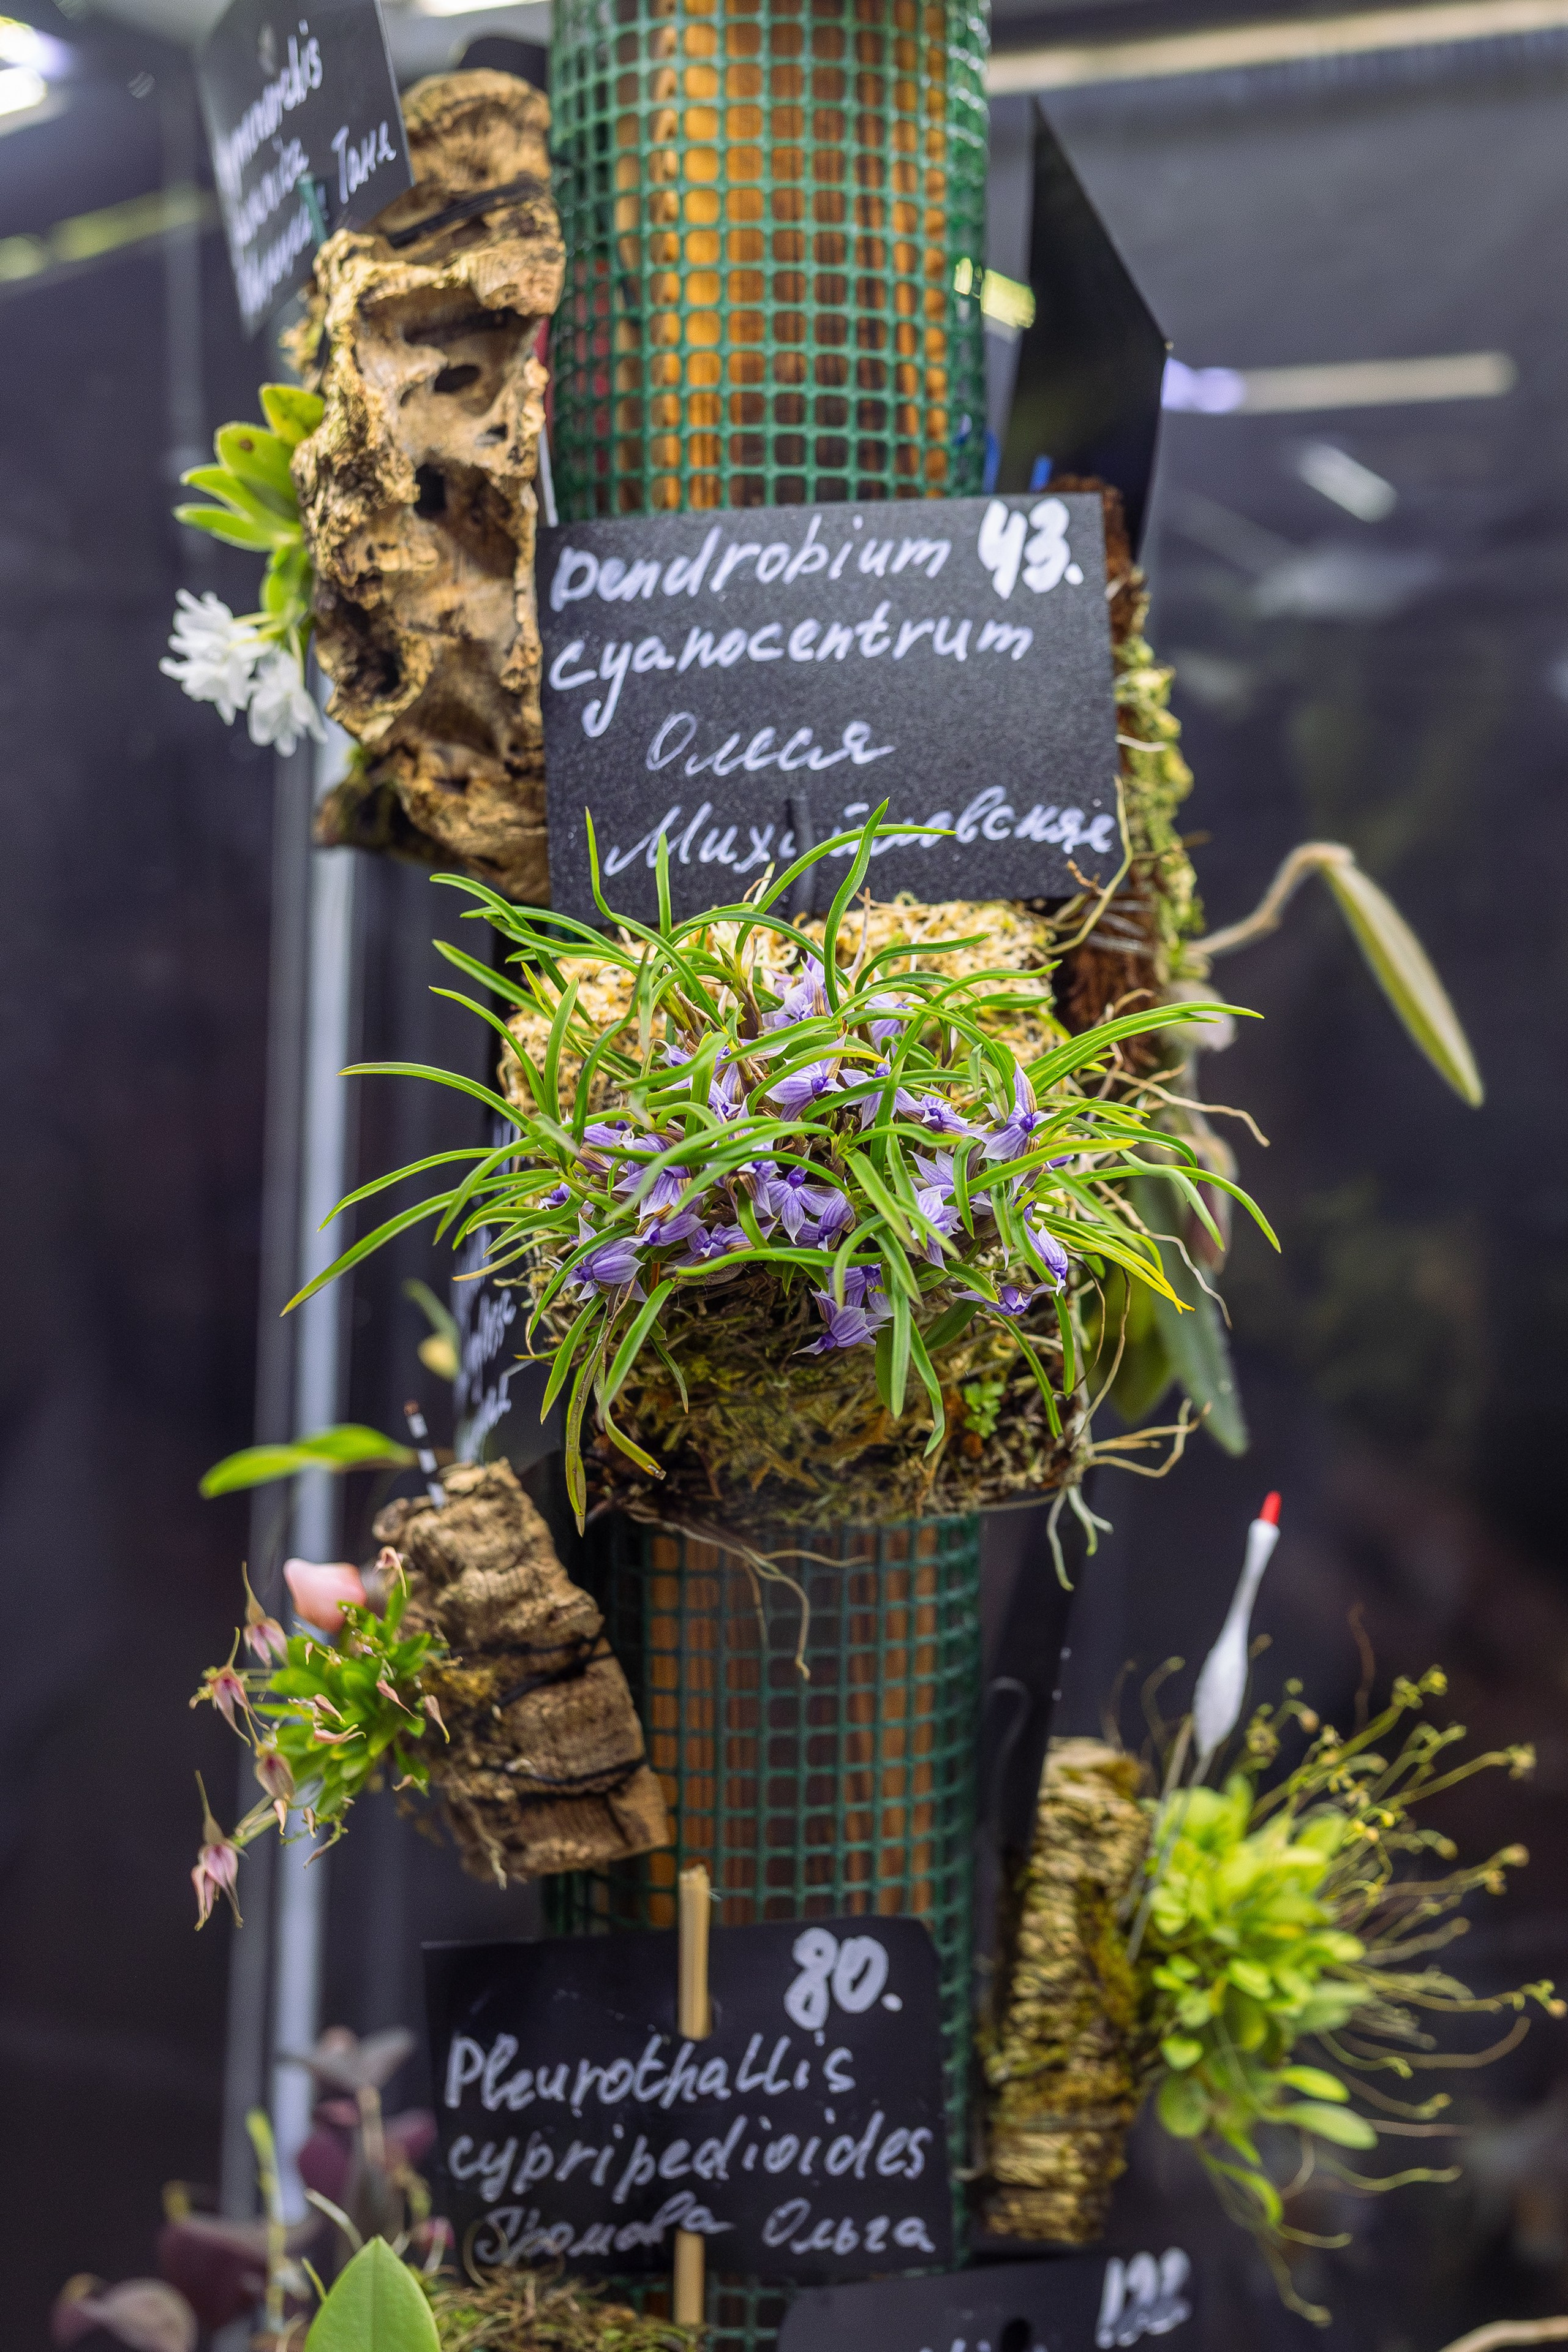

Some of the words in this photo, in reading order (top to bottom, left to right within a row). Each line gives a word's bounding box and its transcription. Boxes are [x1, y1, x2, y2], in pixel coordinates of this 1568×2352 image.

[551, 513, 952, 611] Dendrobium
[978, 499, 1084, 600] 43.
[550, 600, 1034, 738] cyanocentrum
[784, 1928, 903, 2030] 80.
[445, 2031, 856, 2112] Pleurothallis
[448, 2107, 933, 2204] cypripedioides
